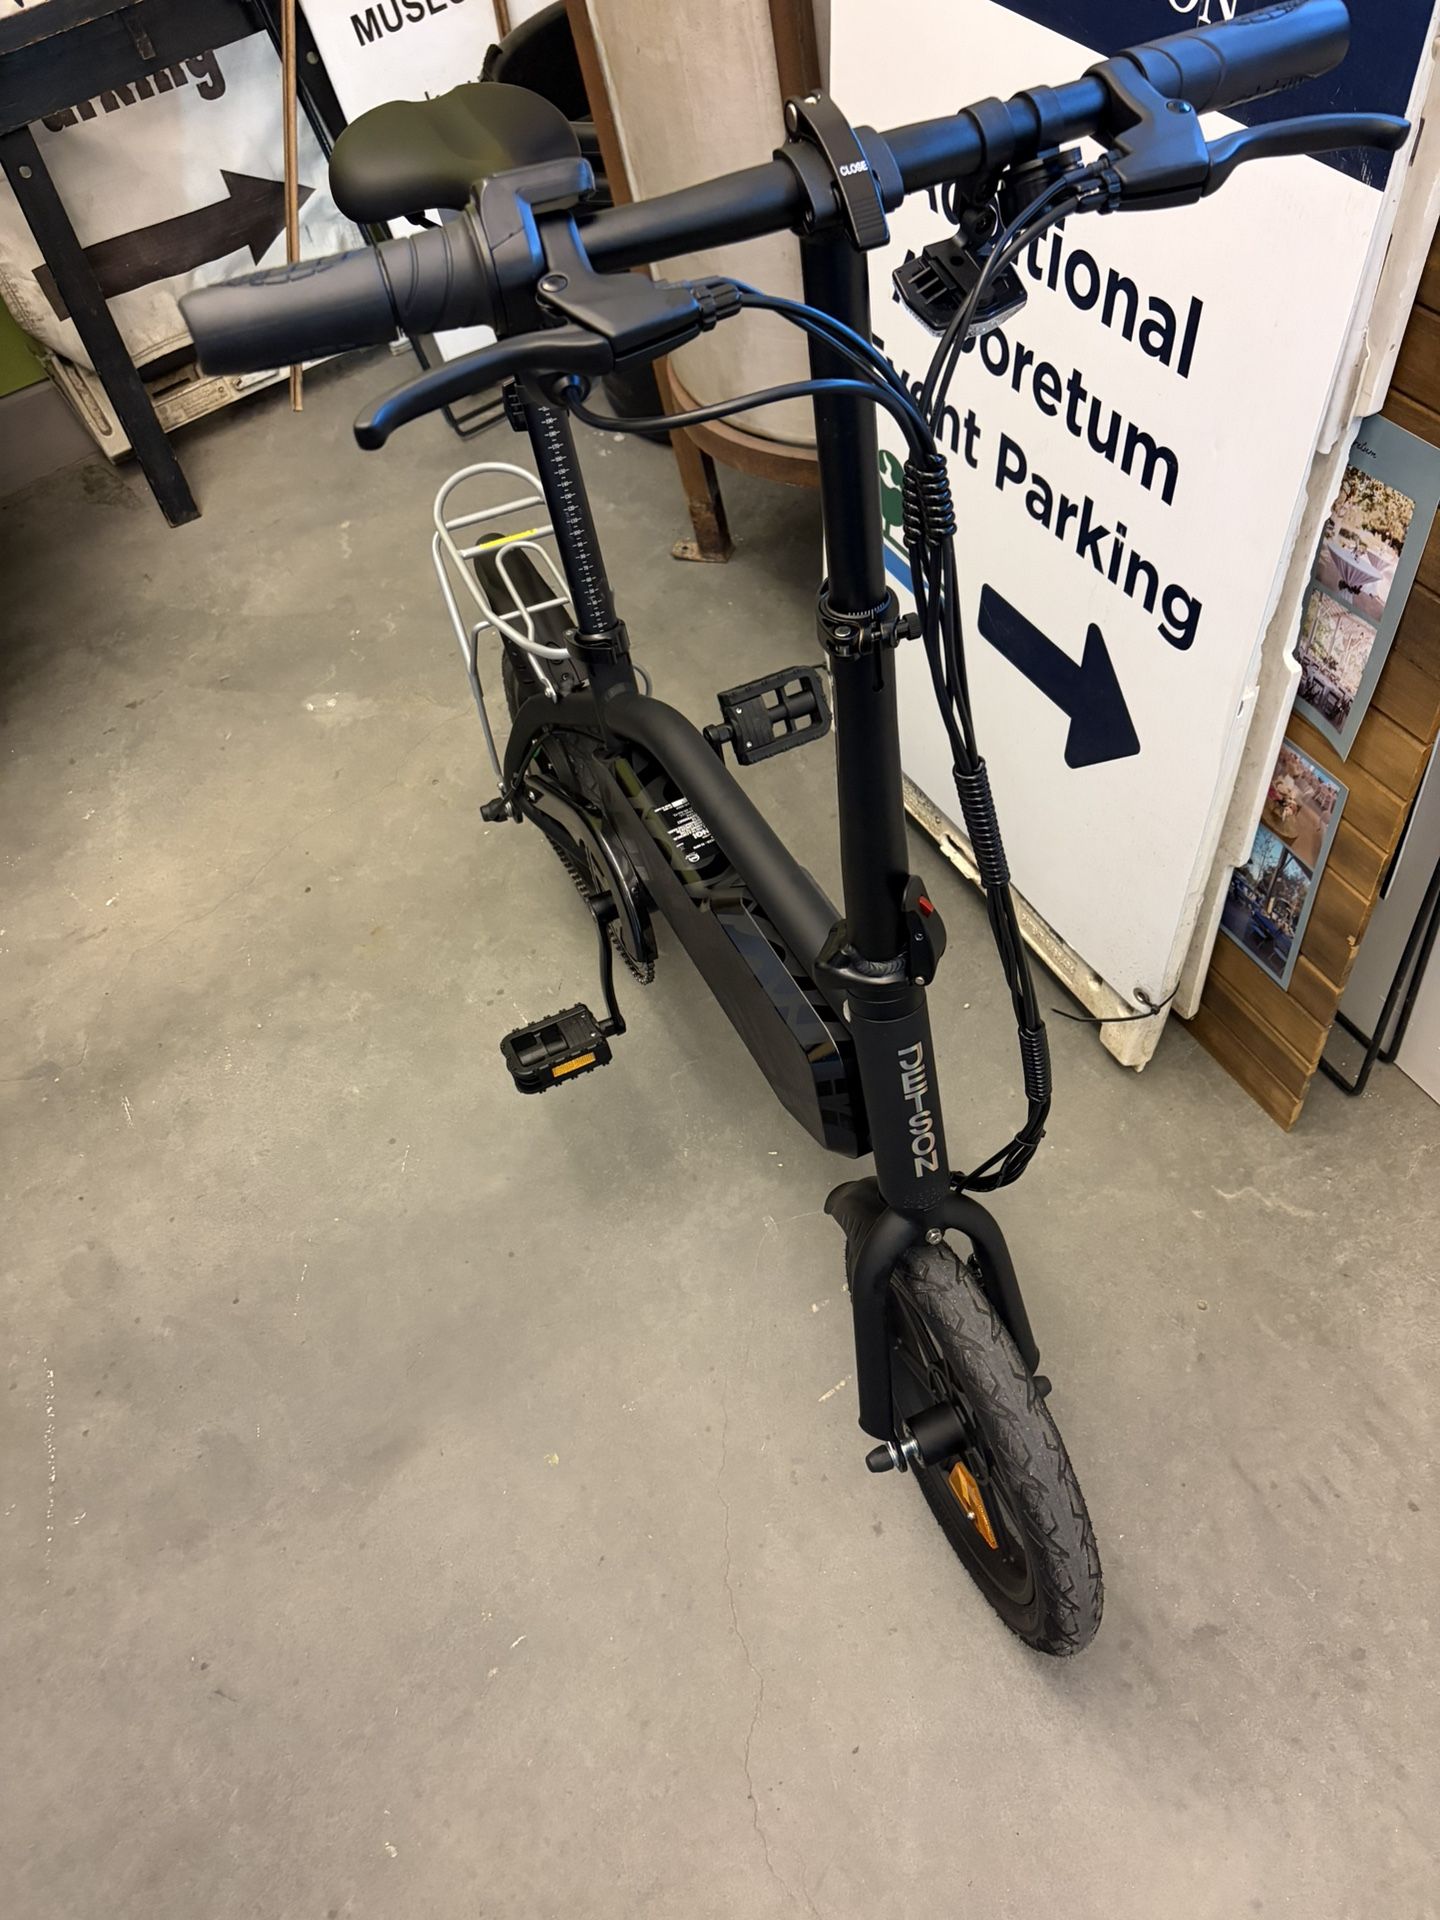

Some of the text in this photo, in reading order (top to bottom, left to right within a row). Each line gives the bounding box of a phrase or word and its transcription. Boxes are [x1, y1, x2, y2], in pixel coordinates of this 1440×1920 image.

[840, 161, 868, 176] CLOSE
[994, 432, 1203, 651] Parking
[898, 1041, 939, 1178] JETSON
